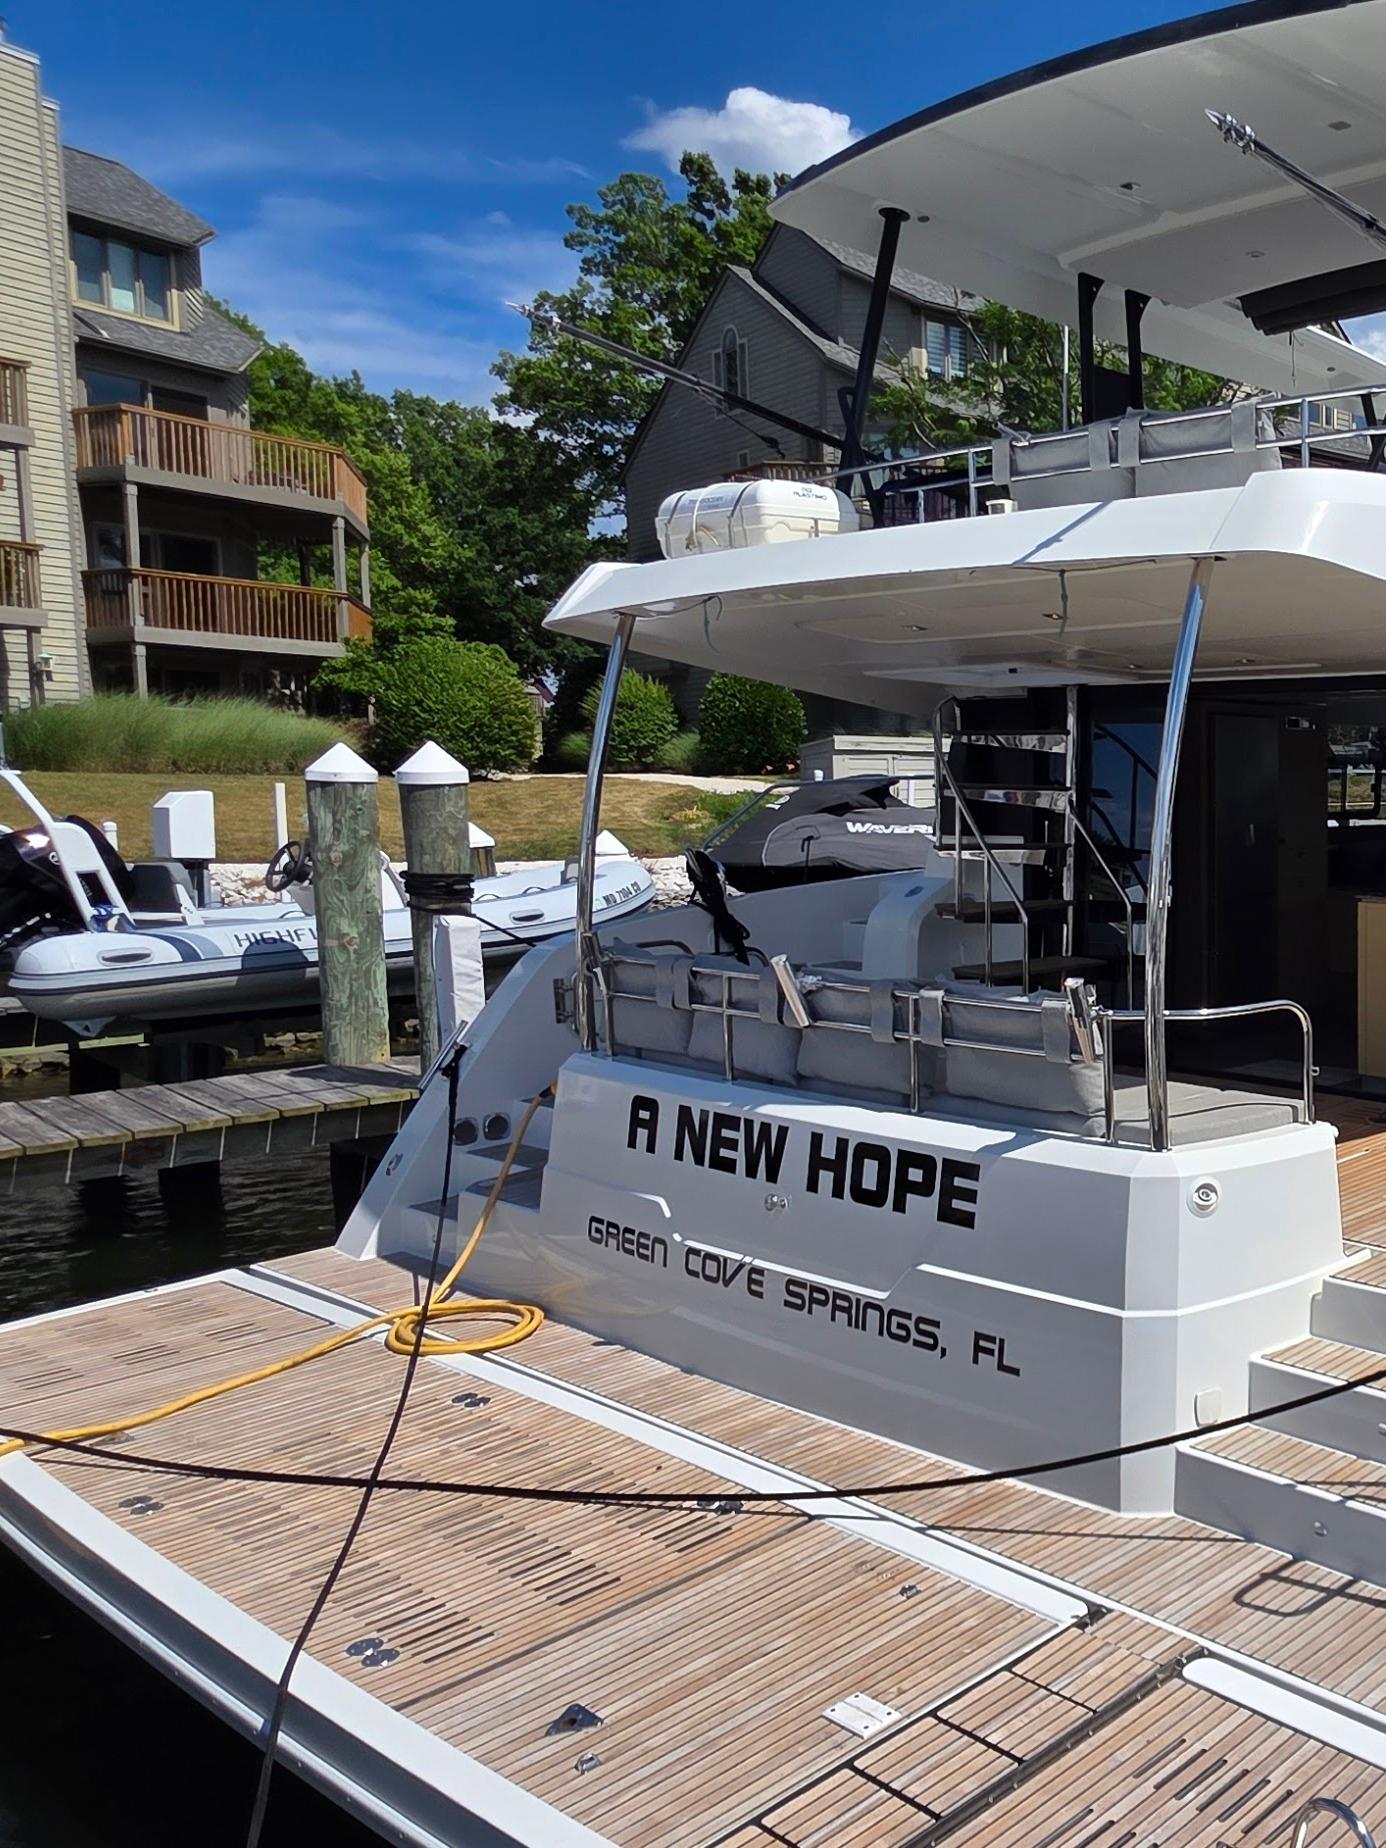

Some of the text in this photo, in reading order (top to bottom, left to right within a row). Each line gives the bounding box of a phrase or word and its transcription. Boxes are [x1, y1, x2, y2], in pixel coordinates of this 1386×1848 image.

[627, 1094, 981, 1230] A NEW HOPE
[587, 1215, 1021, 1377] GREEN COVE SPRINGS, FL
